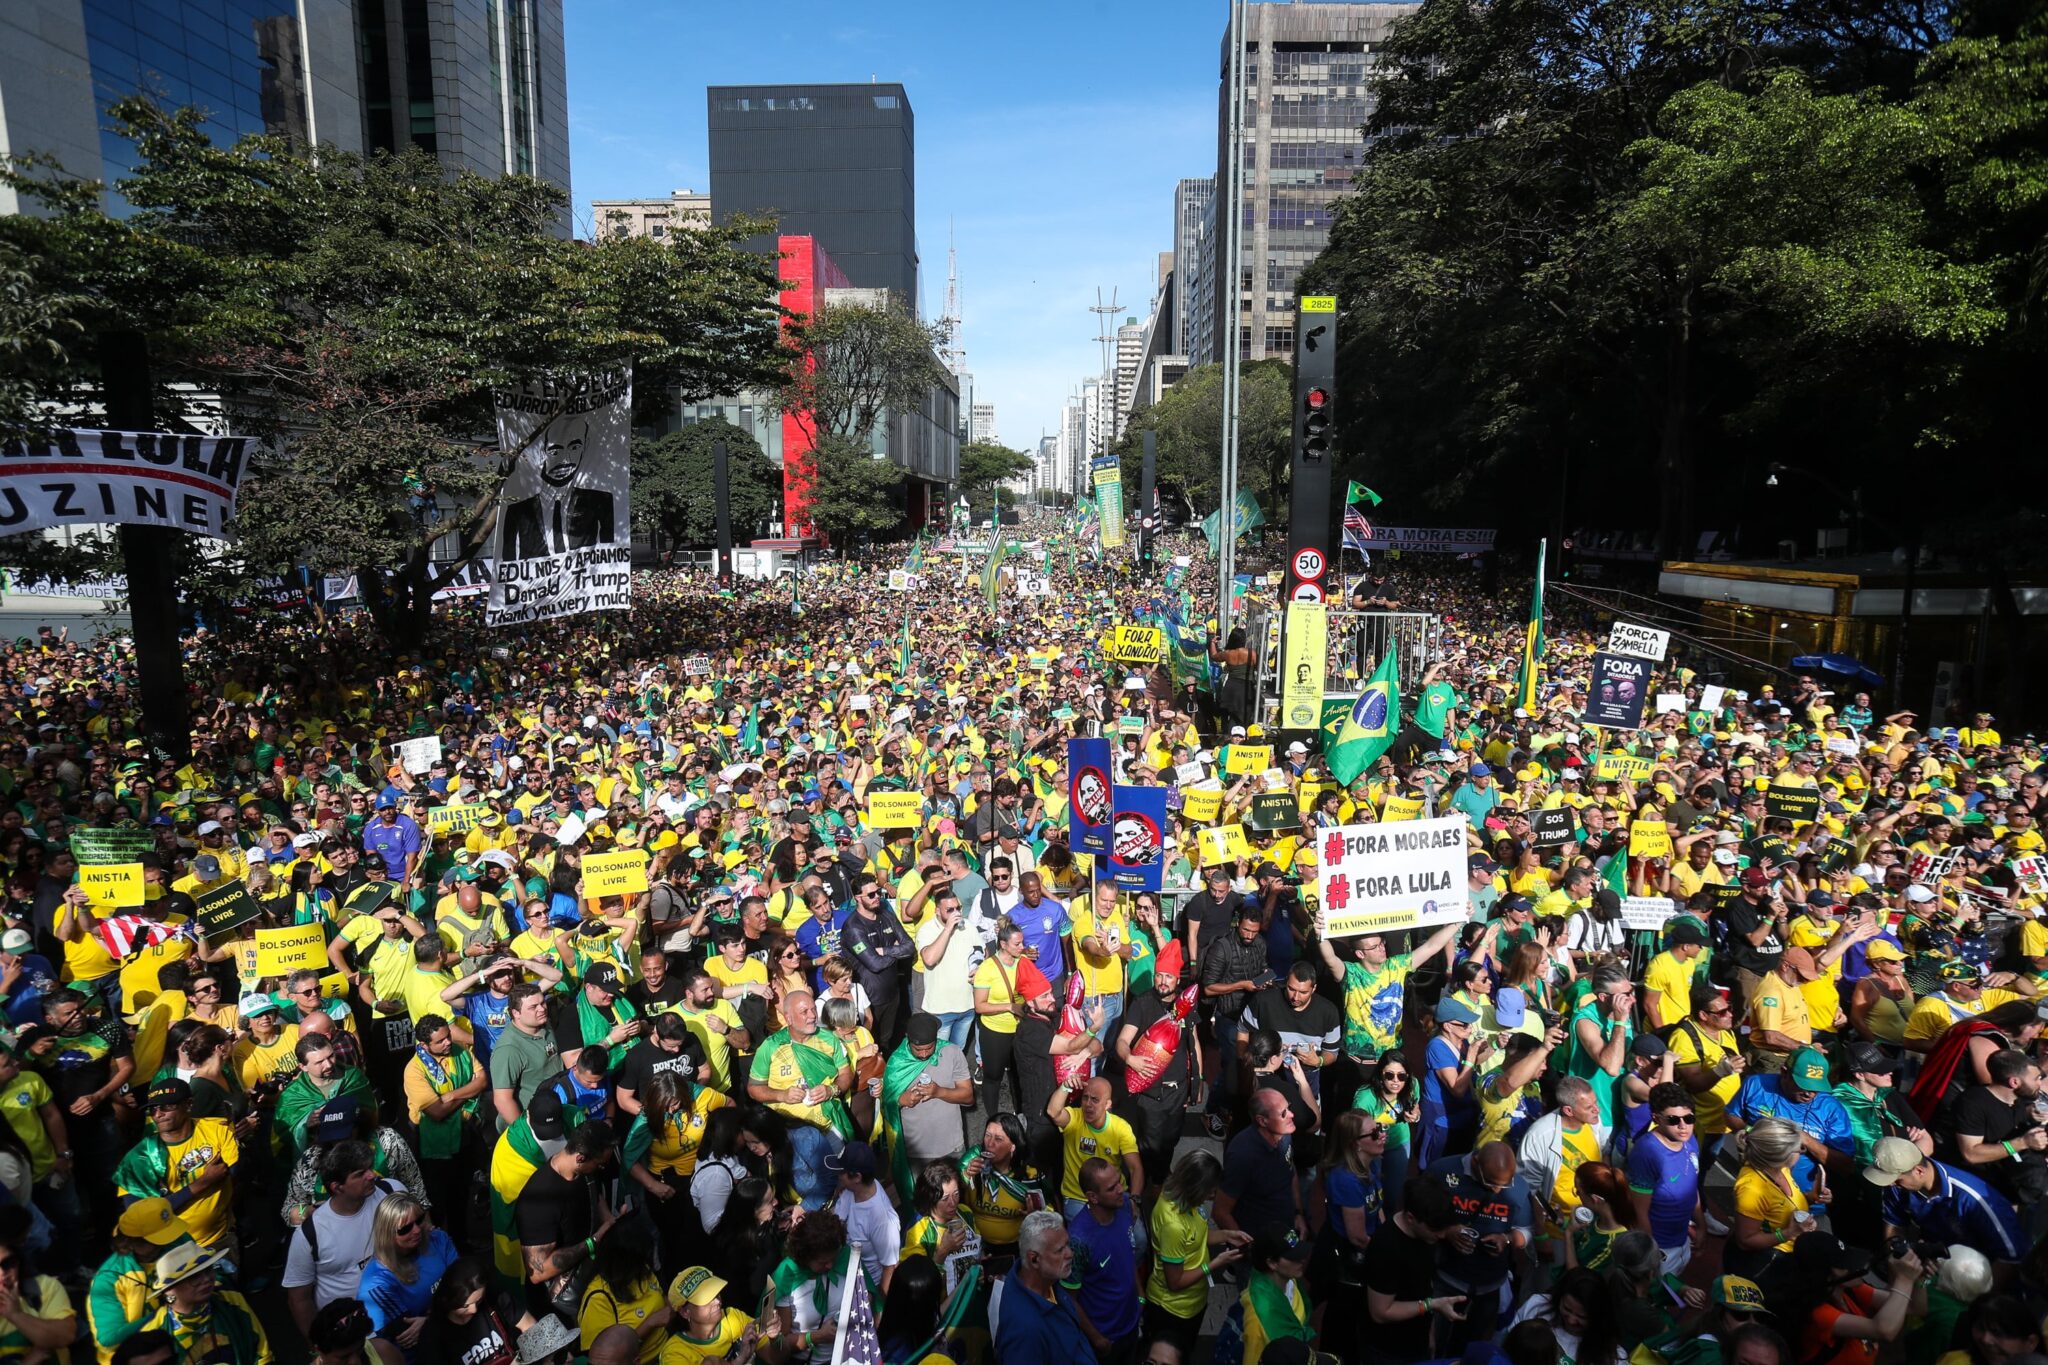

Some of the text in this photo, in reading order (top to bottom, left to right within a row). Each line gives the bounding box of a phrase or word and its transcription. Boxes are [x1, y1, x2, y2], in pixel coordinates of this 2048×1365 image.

[1311, 300, 1333, 309] 2825
[101, 431, 246, 488] LULA
[1389, 542, 1453, 551] BUZINE
[565, 556, 572, 571] O
[1299, 555, 1320, 570] 50
[1030, 572, 1048, 580] LIXO
[60, 586, 111, 598] FRAUDE
[505, 568, 629, 606] Donald Trump
[488, 588, 632, 626] Thank you very much
[1124, 629, 1153, 643] FORA
[1116, 643, 1158, 659] XANDÃO
[1603, 659, 1643, 676] FORA
[1604, 759, 1650, 771] ANISTIA
[1092, 785, 1106, 803] LULA
[1768, 792, 1818, 803] BOLSONARO
[1261, 798, 1293, 808] ANISTIA
[1780, 804, 1803, 813] LIVRE
[1273, 812, 1284, 821] JÁ
[1545, 813, 1564, 825] SOS
[449, 818, 471, 831] JÁ!
[1395, 828, 1461, 851] MORAES
[1539, 828, 1569, 840] TRUMP
[1114, 841, 1134, 858] FORA
[1134, 830, 1155, 847] LULA
[586, 861, 642, 874] BOLSONARO
[86, 872, 131, 883] ANISTIA
[603, 876, 627, 886] LIVRE
[1355, 875, 1404, 899] FORA
[1408, 870, 1452, 893] LULA
[102, 887, 115, 900] JÁ
[211, 908, 236, 924] LIVRE
[1330, 914, 1415, 931] PELA NOSSA LIBERDADE
[259, 934, 321, 950] BOLSONARO
[151, 944, 164, 956] 10
[277, 952, 307, 964] LIVRE
[1806, 1068, 1824, 1079] 22
[324, 1112, 344, 1122] AGRO
[461, 1329, 505, 1365] FORA
